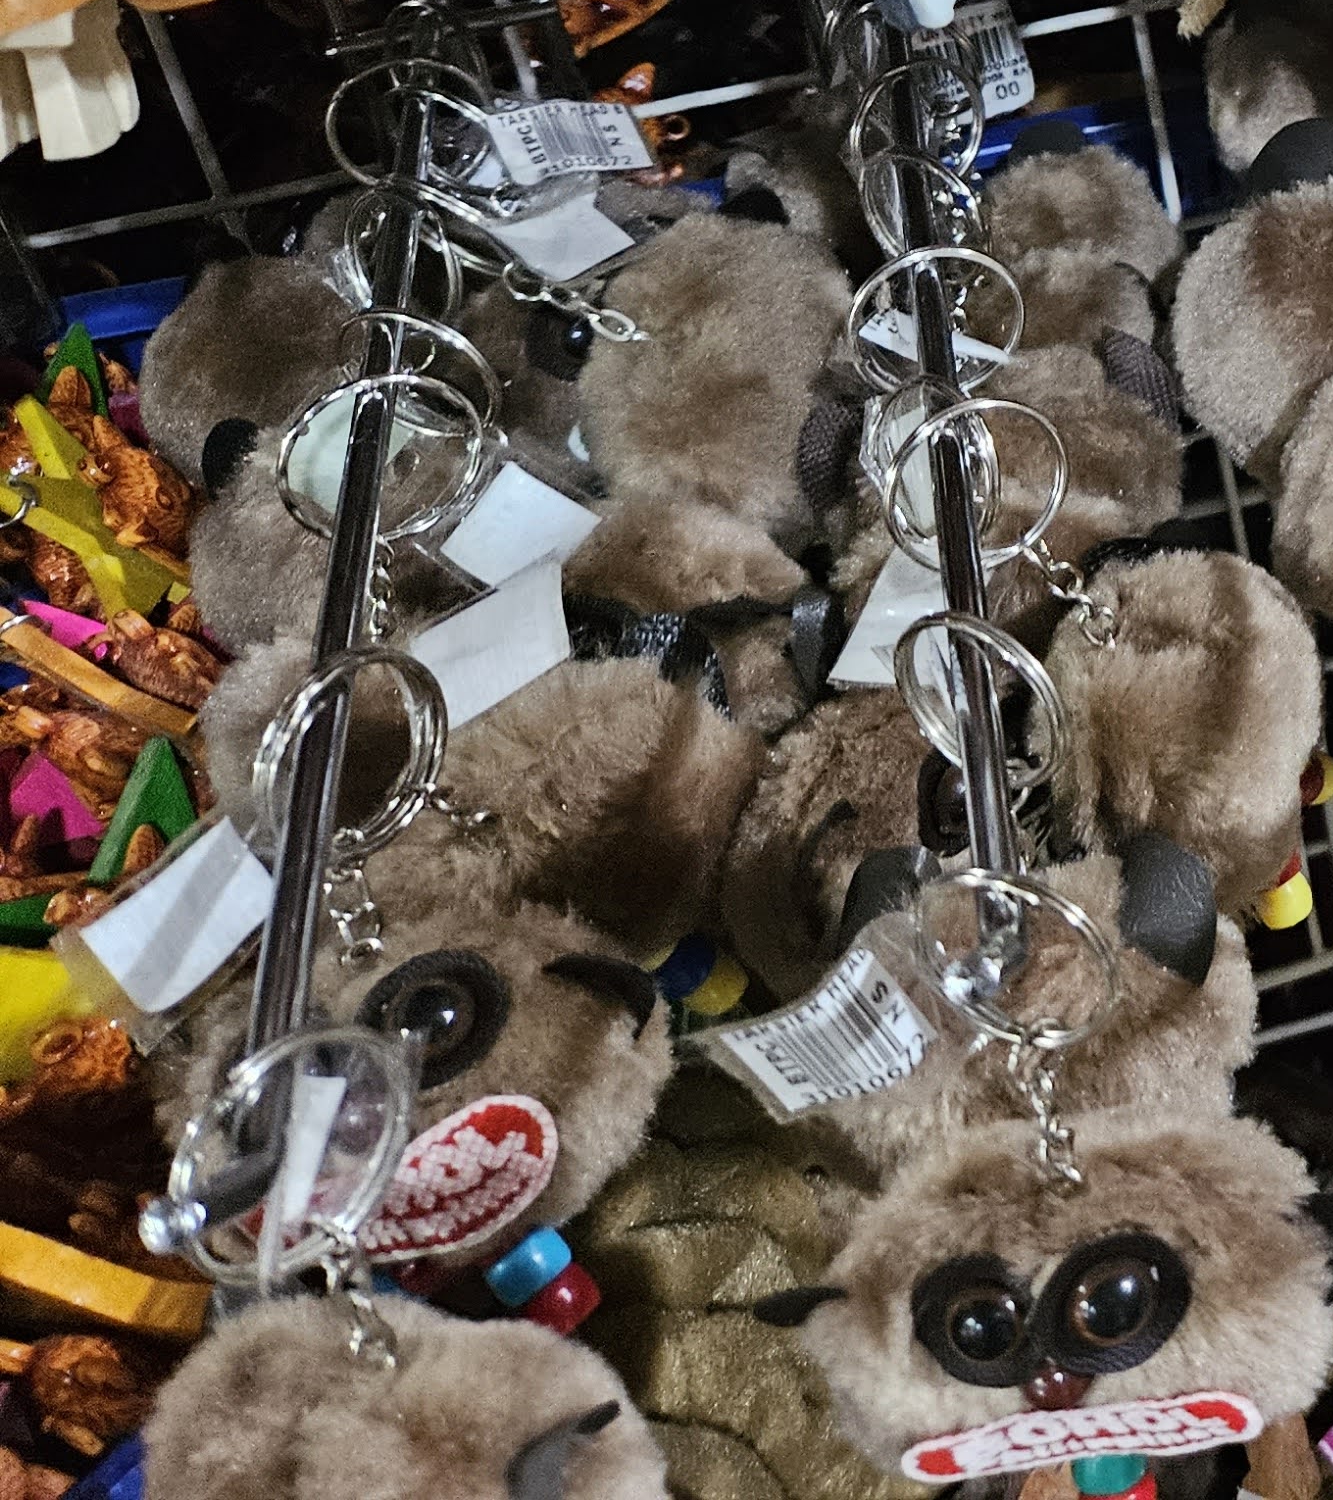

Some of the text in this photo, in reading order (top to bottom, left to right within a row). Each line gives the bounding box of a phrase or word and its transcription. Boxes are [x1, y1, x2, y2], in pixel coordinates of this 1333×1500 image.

[516, 123, 548, 165] BTPC
[602, 123, 624, 147] N S
[870, 980, 905, 1026] N S
